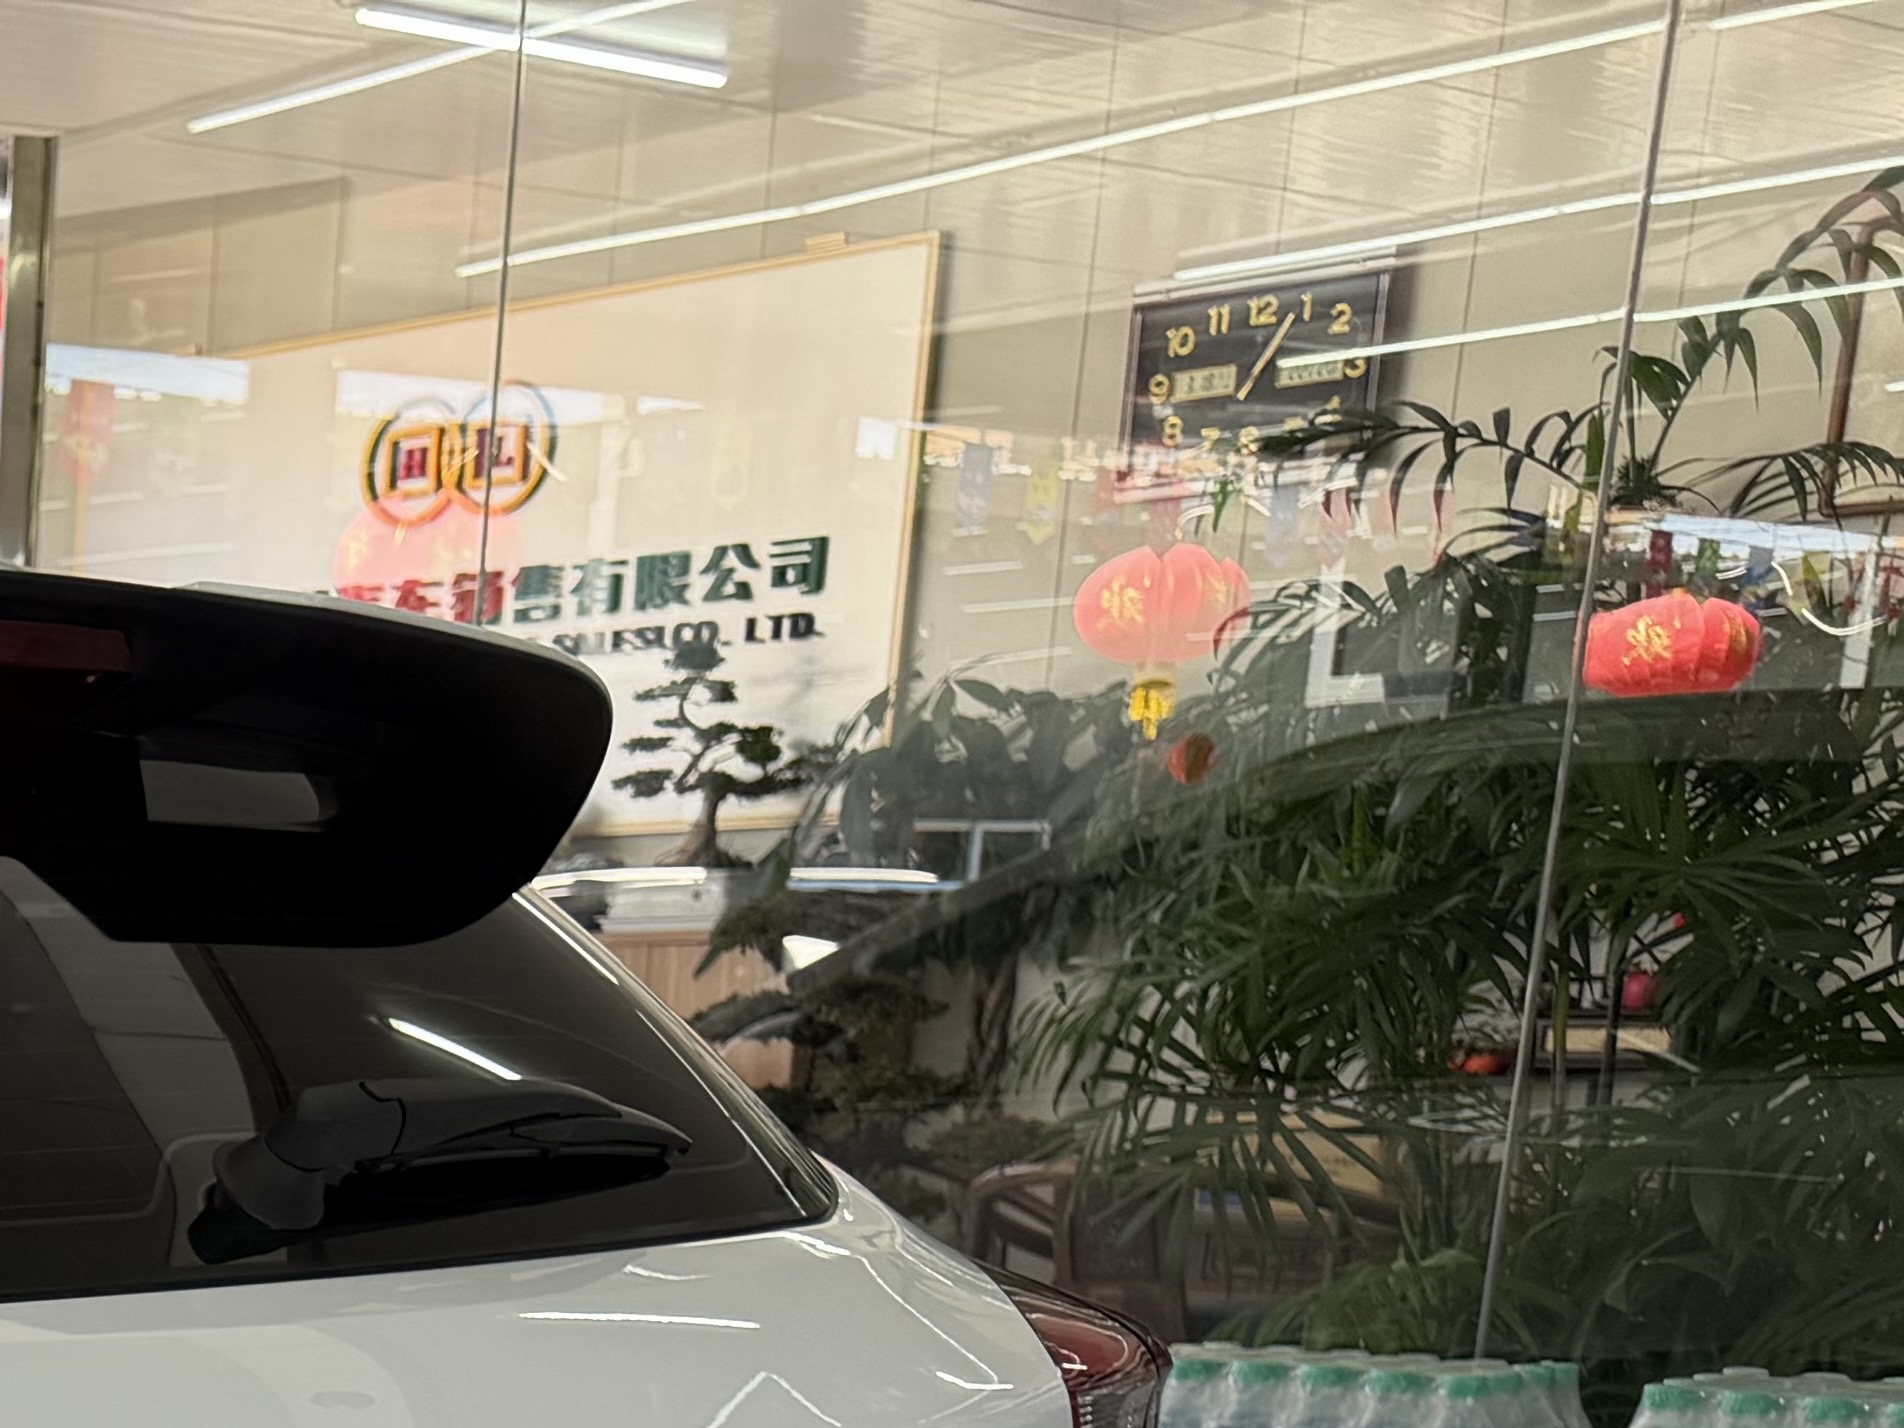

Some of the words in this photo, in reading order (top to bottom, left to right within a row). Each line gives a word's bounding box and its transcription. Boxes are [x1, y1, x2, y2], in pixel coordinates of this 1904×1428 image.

[1207, 303, 1231, 336] 11
[1247, 294, 1279, 326] 12
[1327, 302, 1353, 335] 2
[1166, 325, 1196, 357] 10
[1149, 373, 1170, 405] 9
[338, 536, 830, 626] 车销售有限公司
